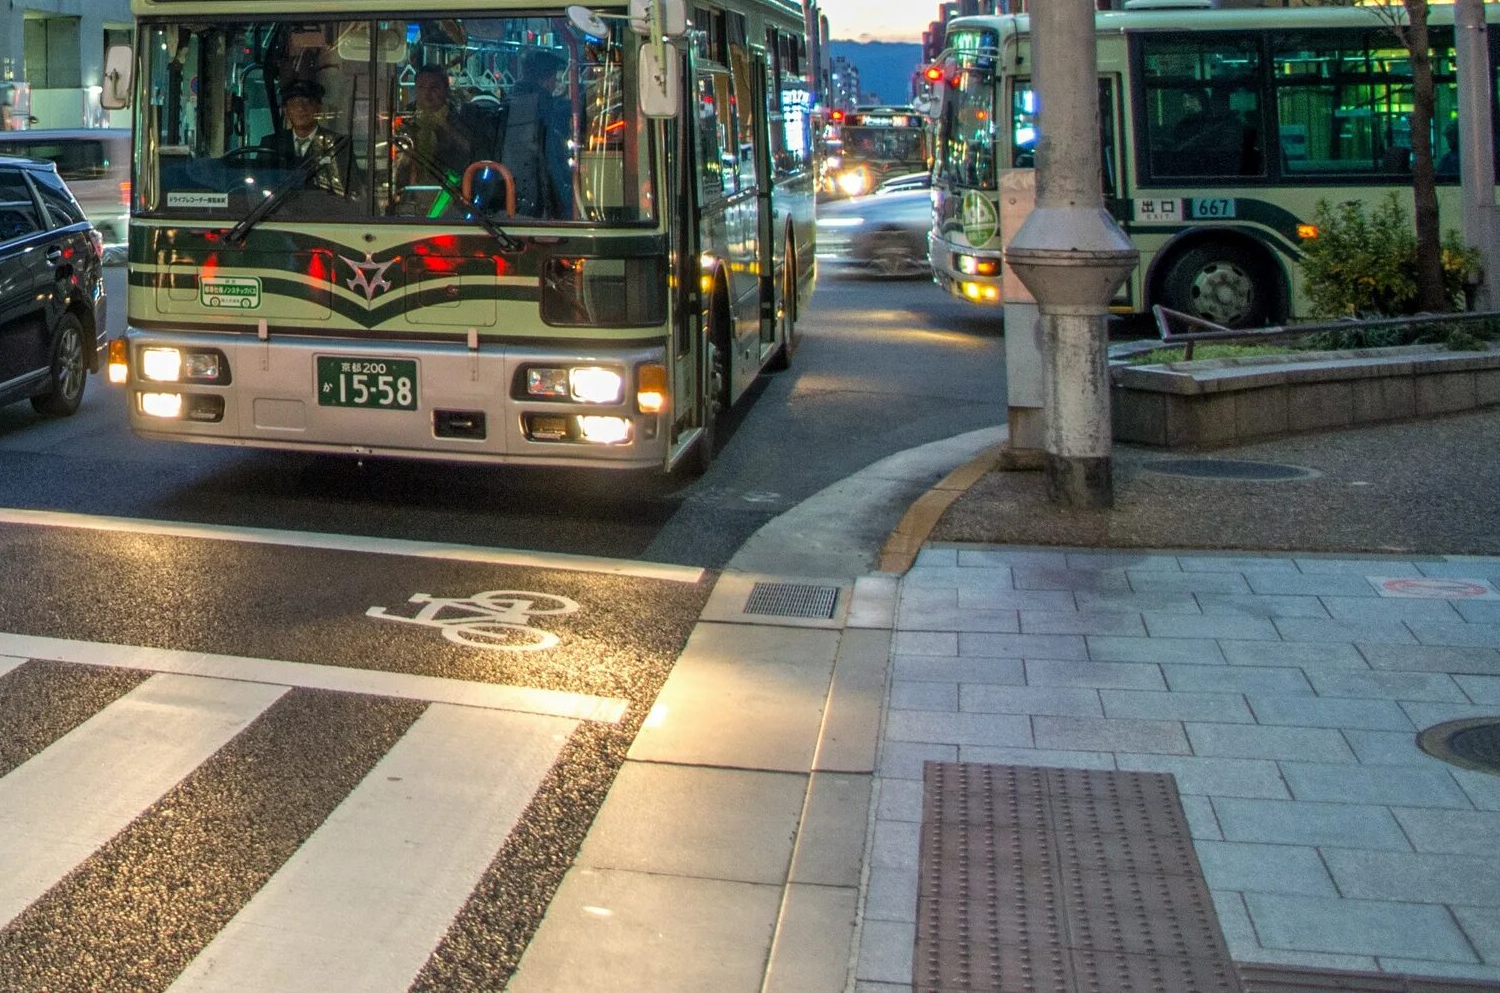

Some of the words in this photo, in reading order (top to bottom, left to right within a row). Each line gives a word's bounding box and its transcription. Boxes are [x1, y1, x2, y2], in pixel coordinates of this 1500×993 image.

[1141, 200, 1175, 214] 出口
[1198, 200, 1229, 216] 667
[322, 382, 333, 393] か
[340, 373, 413, 406] 15-58
